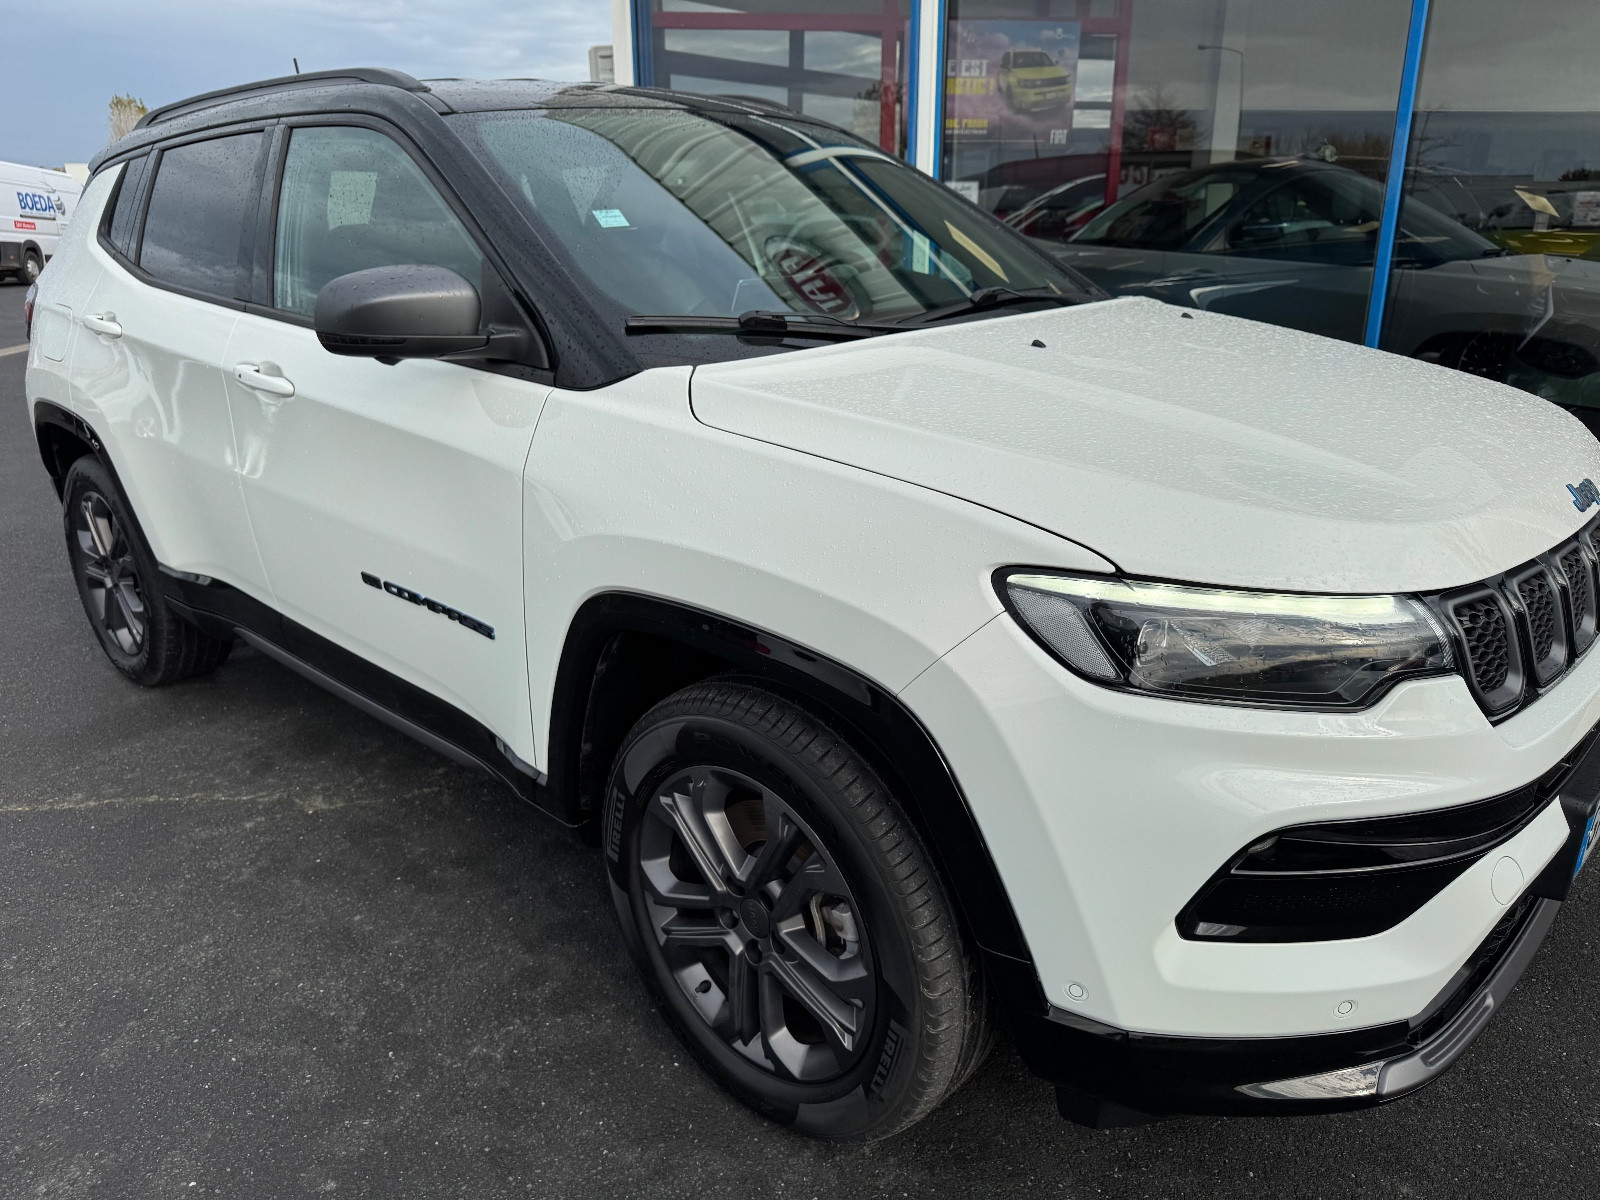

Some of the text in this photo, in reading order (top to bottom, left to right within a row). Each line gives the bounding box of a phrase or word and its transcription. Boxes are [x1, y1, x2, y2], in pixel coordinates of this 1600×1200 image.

[1050, 129, 1068, 145] FIAT
[17, 192, 56, 213] BOEDA
[606, 786, 626, 862] PIRELLI
[870, 1017, 911, 1097] PIRELLI
